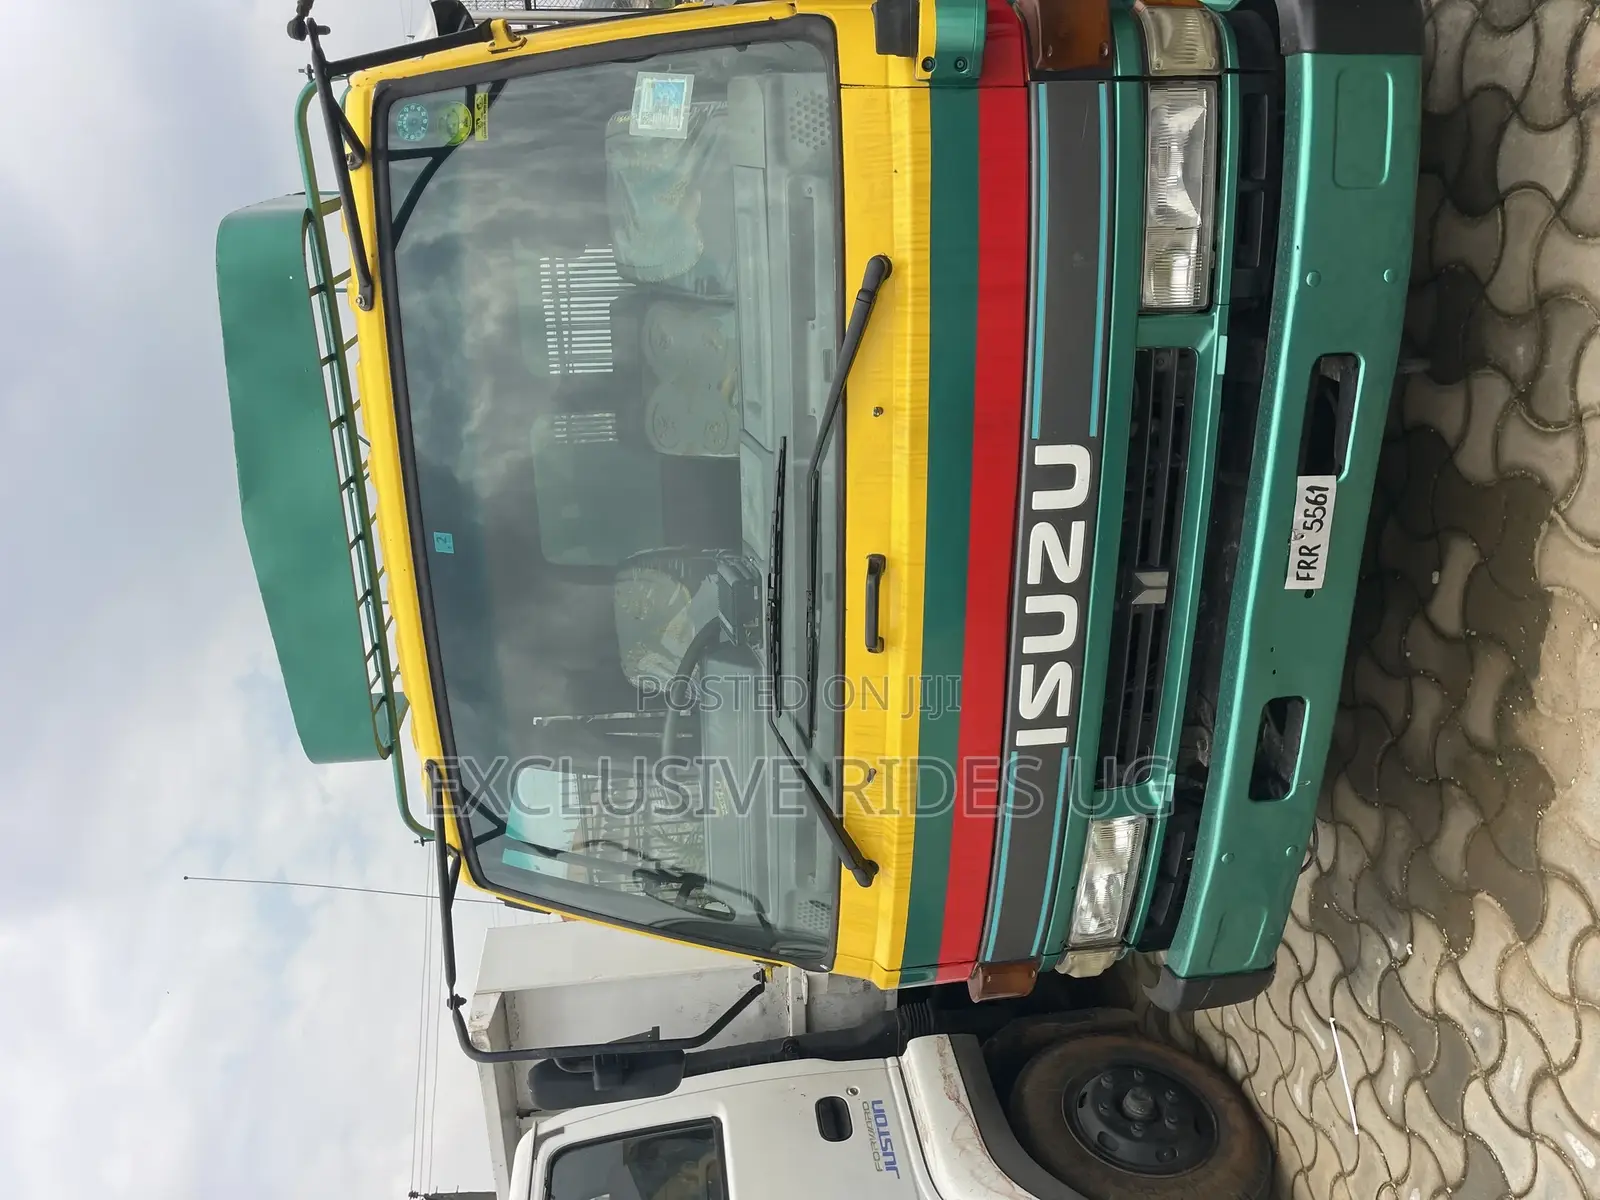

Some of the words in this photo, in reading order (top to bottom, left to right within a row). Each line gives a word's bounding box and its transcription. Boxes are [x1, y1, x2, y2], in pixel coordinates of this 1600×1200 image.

[1303, 485, 1330, 533] 5561
[1296, 544, 1322, 581] FRR
[1016, 444, 1092, 746] ISUZU
[862, 1101, 883, 1172] FORWARD
